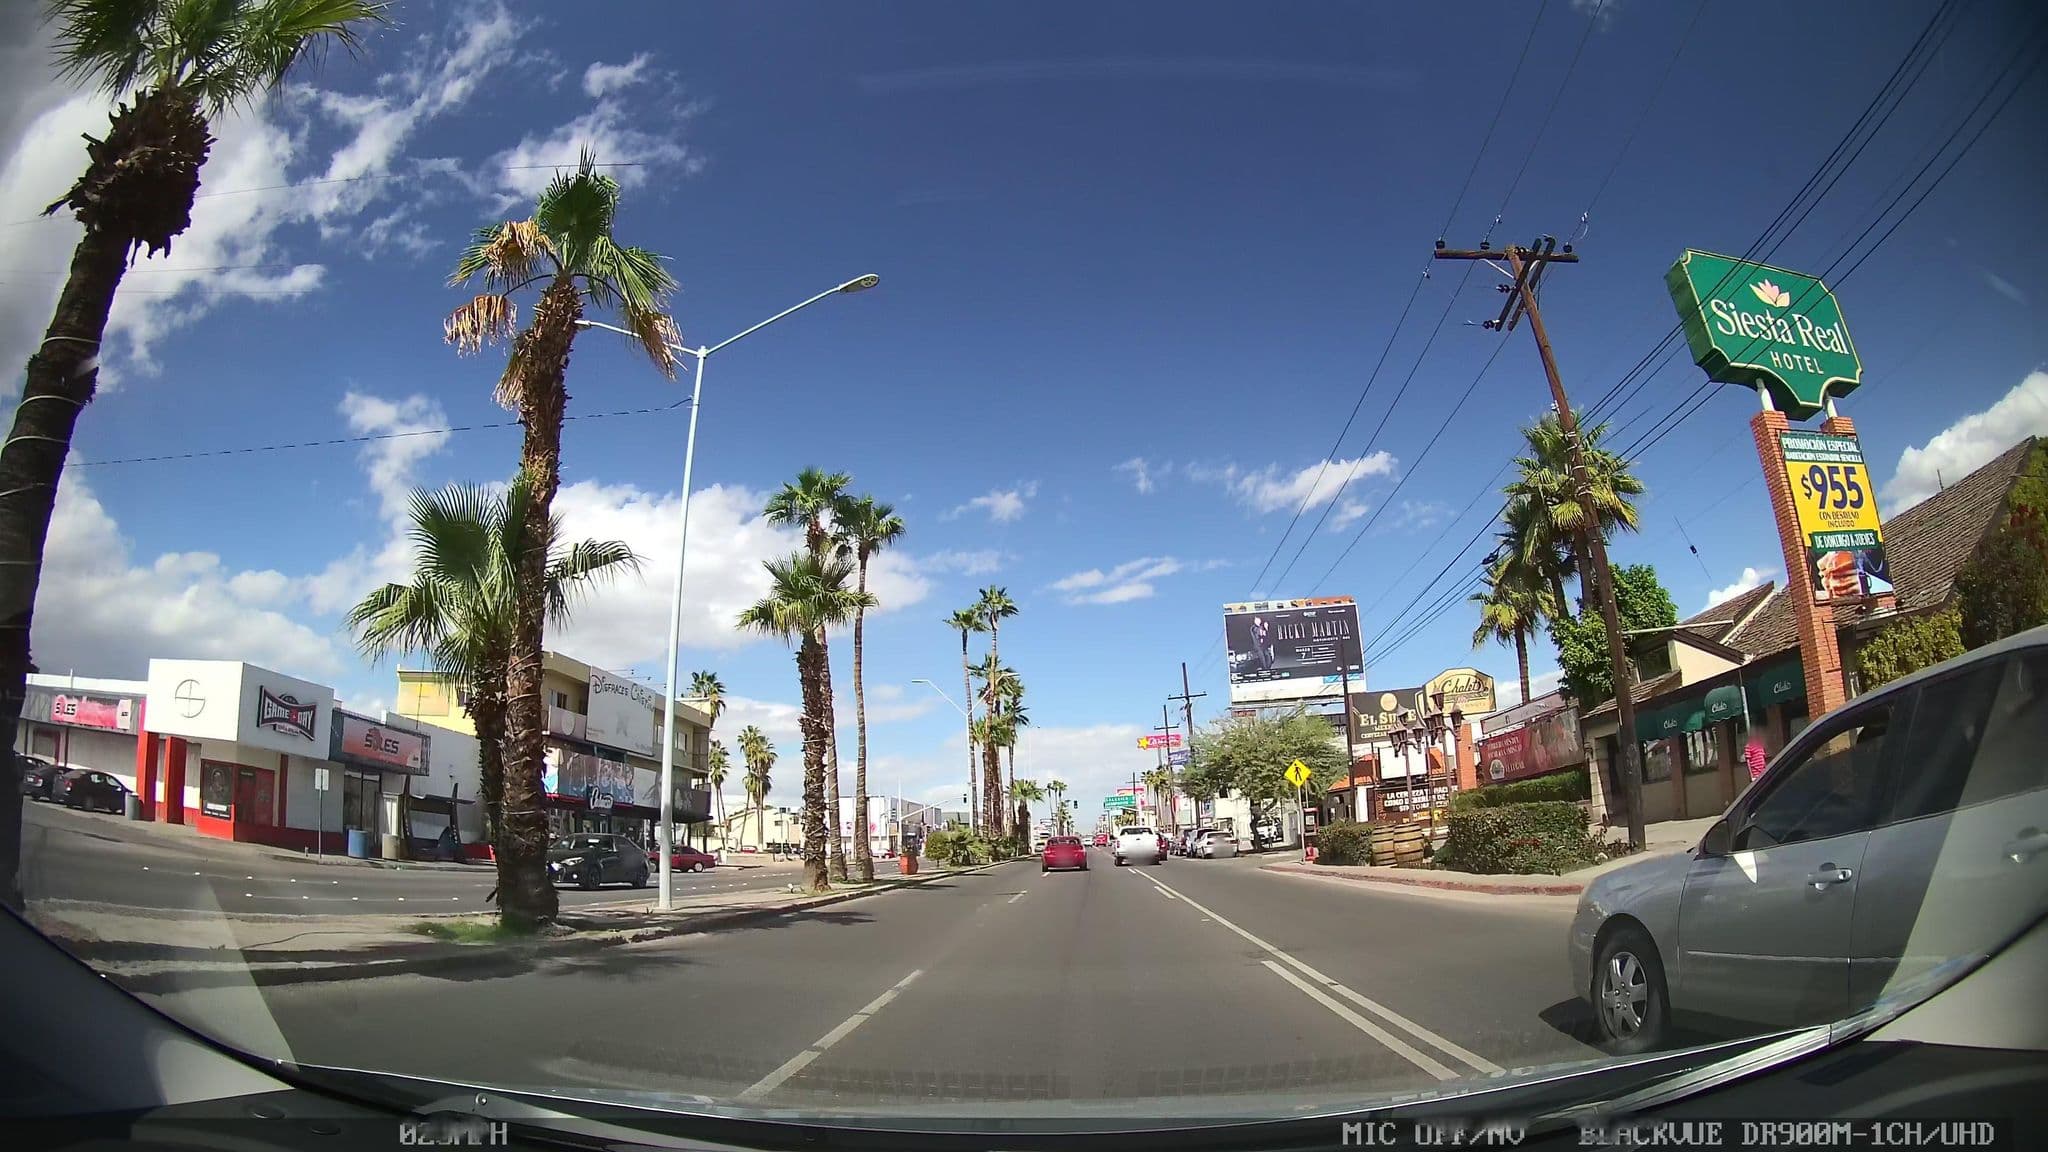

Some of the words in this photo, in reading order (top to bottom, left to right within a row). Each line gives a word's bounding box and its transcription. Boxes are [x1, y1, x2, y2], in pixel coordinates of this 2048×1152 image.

[1711, 299, 1795, 345] Siesta
[1792, 313, 1849, 354] Real
[1770, 350, 1824, 374] HOTEL
[1801, 464, 1864, 509] $955
[1814, 535, 1824, 548] DE
[1277, 622, 1305, 640] RICKY
[1311, 619, 1350, 637] MARTIN
[263, 697, 290, 719] GAME
[297, 710, 314, 731] DAY
